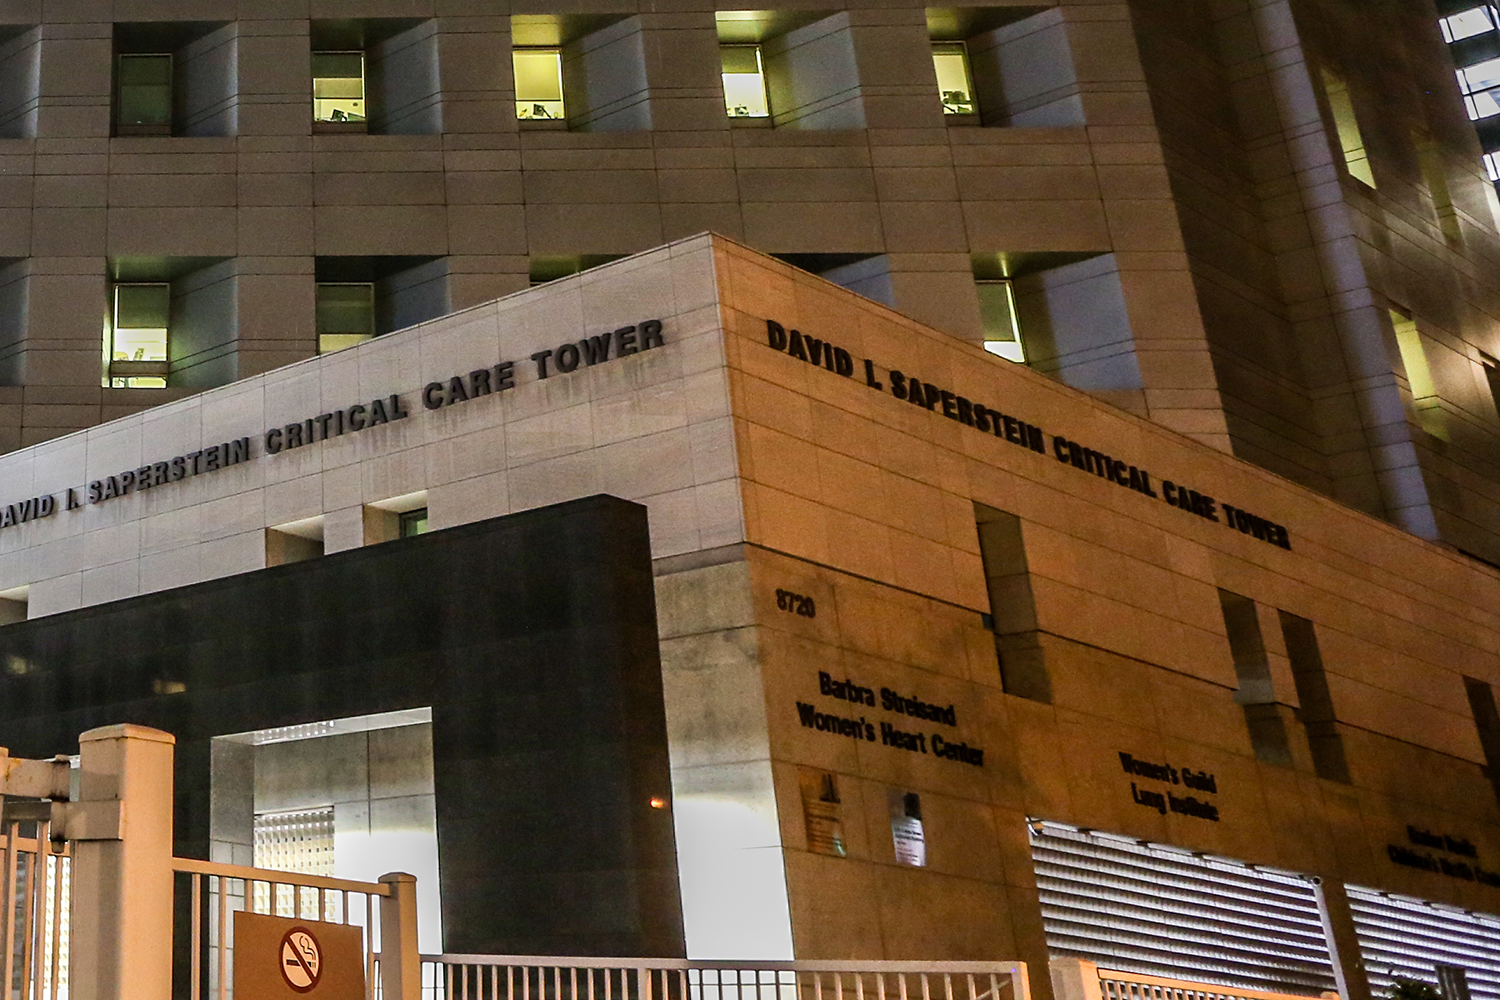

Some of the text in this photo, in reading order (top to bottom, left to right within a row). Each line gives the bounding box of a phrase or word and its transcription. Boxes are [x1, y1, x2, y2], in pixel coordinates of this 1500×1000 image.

[88, 436, 250, 505] SAPERSTEIN
[264, 392, 408, 456] CRITICAL
[422, 361, 514, 411] CARE
[530, 318, 665, 381] TOWER
[767, 319, 854, 378] DAVID
[889, 370, 1045, 455] SAPERSTEIN
[1054, 435, 1157, 498] CRITICAL
[1163, 480, 1220, 523] CARE
[1221, 503, 1292, 552] TOWER
[796, 702, 984, 767] Women's Heart Center
[819, 671, 956, 728] Barbra Streisand
